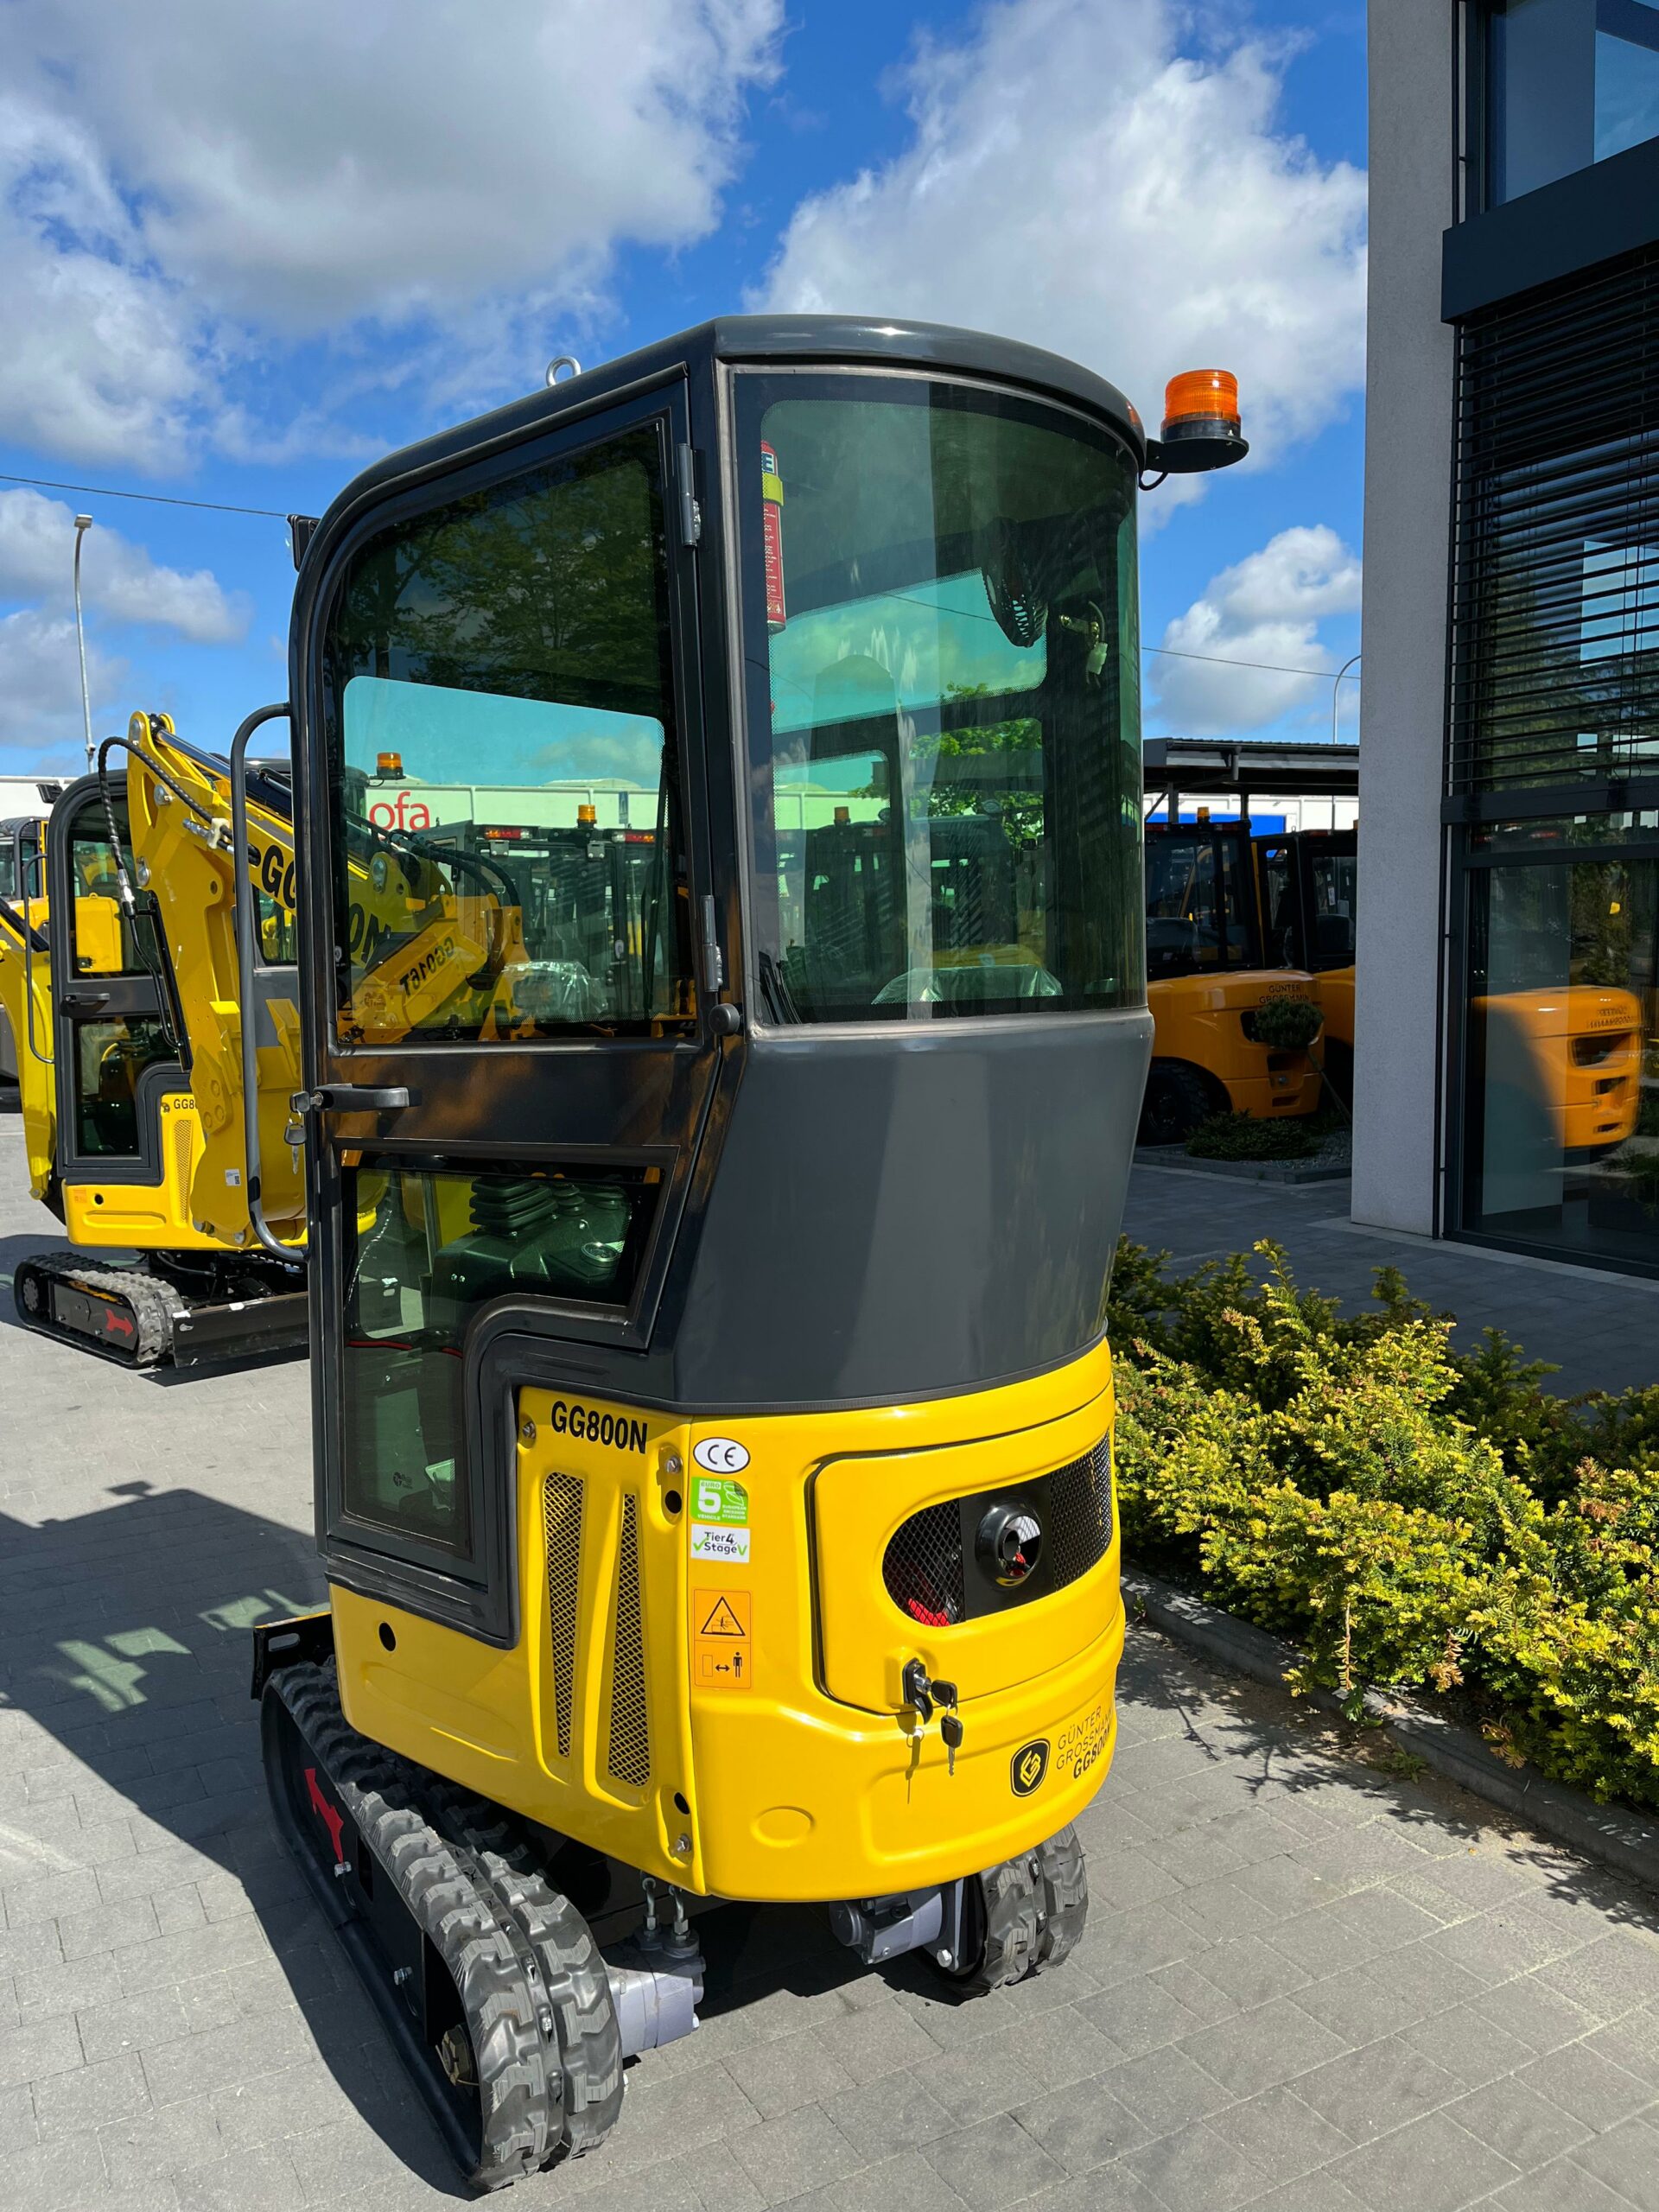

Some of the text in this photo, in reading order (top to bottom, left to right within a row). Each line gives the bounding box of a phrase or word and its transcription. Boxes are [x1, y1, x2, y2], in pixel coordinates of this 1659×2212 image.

[174, 1098, 194, 1109] GG8
[551, 1400, 648, 1454] GG800N
[708, 1444, 736, 1467] CE
[698, 1486, 721, 1514] 5
[1058, 1706, 1102, 1750] GÜNTER
